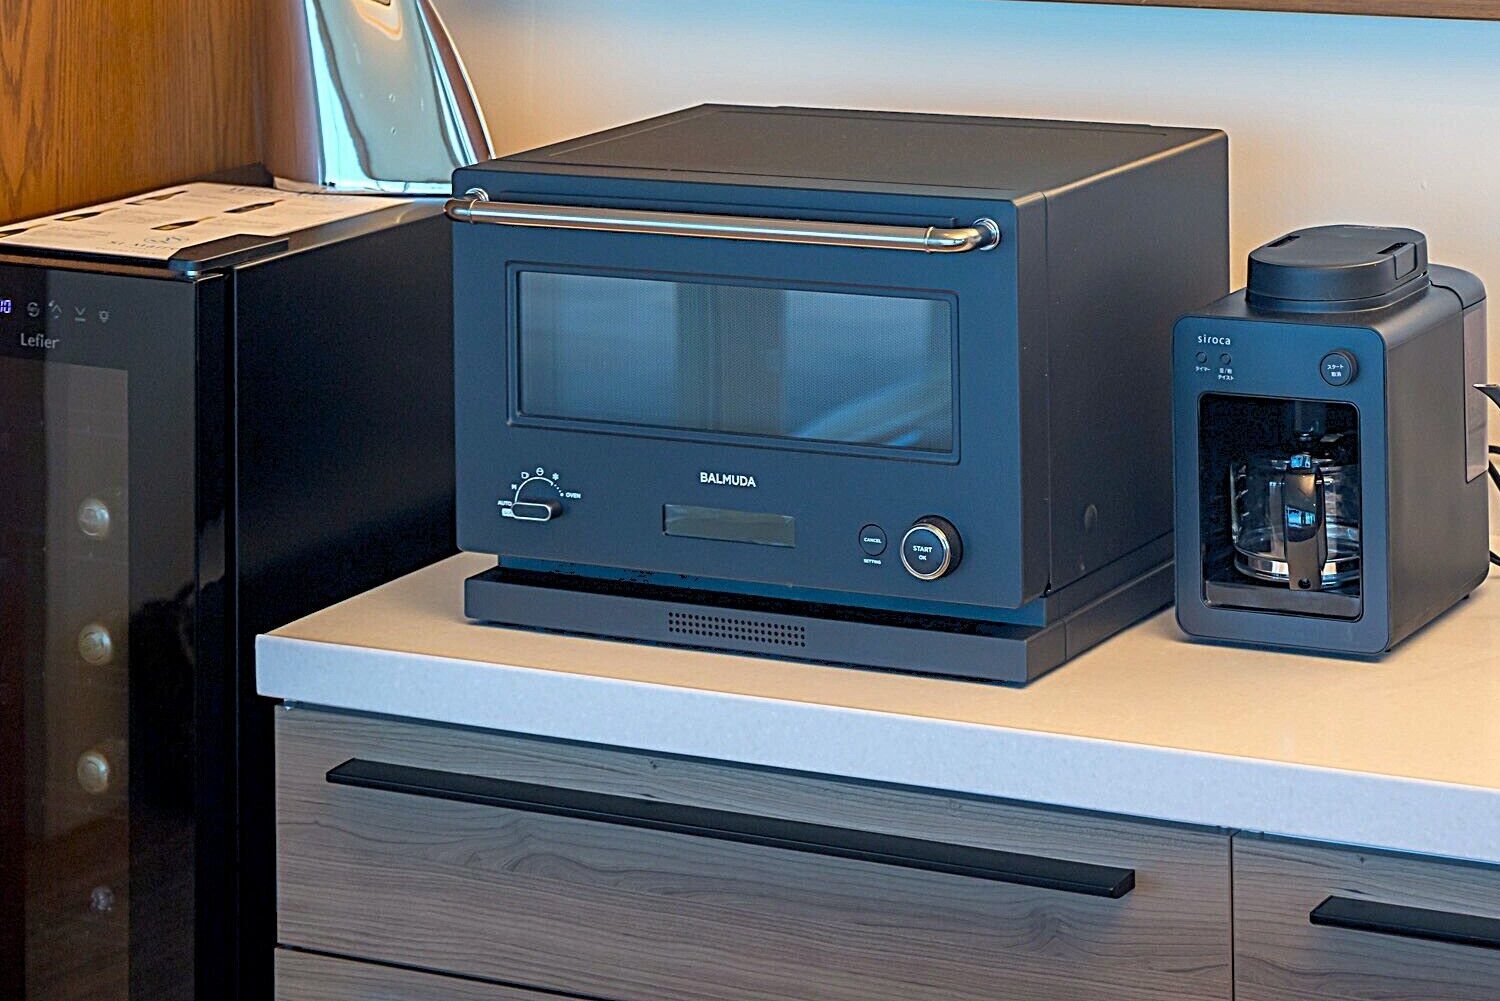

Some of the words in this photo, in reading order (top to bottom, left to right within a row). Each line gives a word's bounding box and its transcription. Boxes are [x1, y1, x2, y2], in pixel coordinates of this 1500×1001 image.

[20, 332, 60, 349] Lefier
[1197, 334, 1231, 346] siroca
[700, 471, 757, 488] BALMUDA
[565, 491, 582, 499] OVEN
